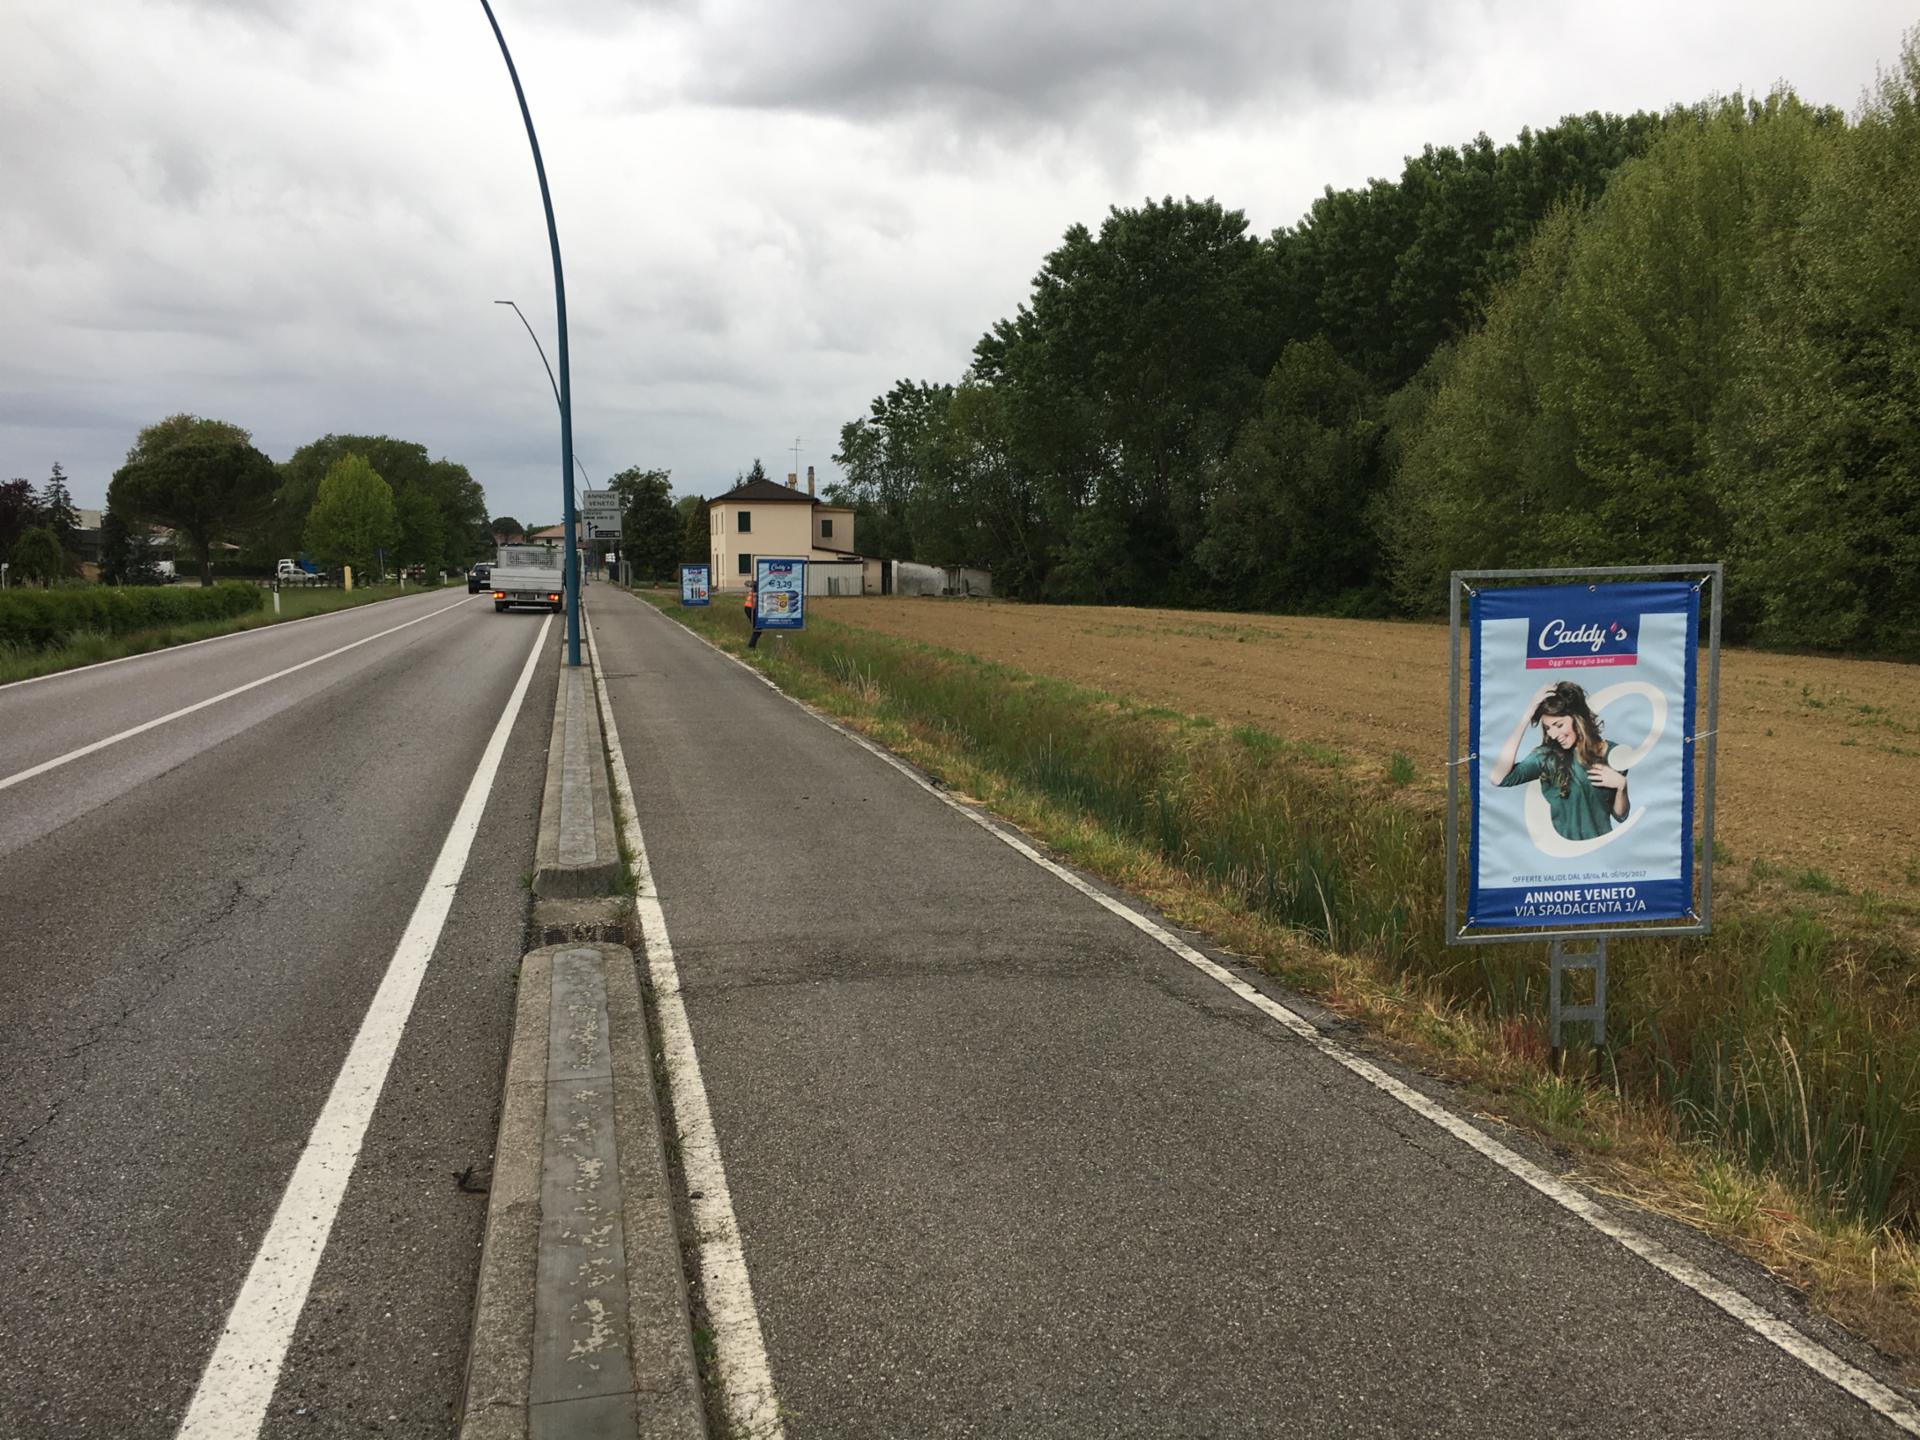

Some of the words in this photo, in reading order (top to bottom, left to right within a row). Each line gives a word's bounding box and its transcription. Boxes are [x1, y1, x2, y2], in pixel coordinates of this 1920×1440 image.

[1538, 619, 1628, 652] Caddy's
[1548, 659, 1564, 667] Oggi
[1512, 874, 1542, 883] OFFERTE
[1544, 873, 1567, 882] VALIDE
[1568, 873, 1580, 881] DAL
[1601, 871, 1609, 879] AL
[1524, 889, 1582, 904] ANNONE
[1584, 886, 1636, 901] VENETO
[1514, 905, 1536, 917] VIA
[1539, 900, 1622, 916] SPADACENTA
[1625, 899, 1647, 912] 1/A
